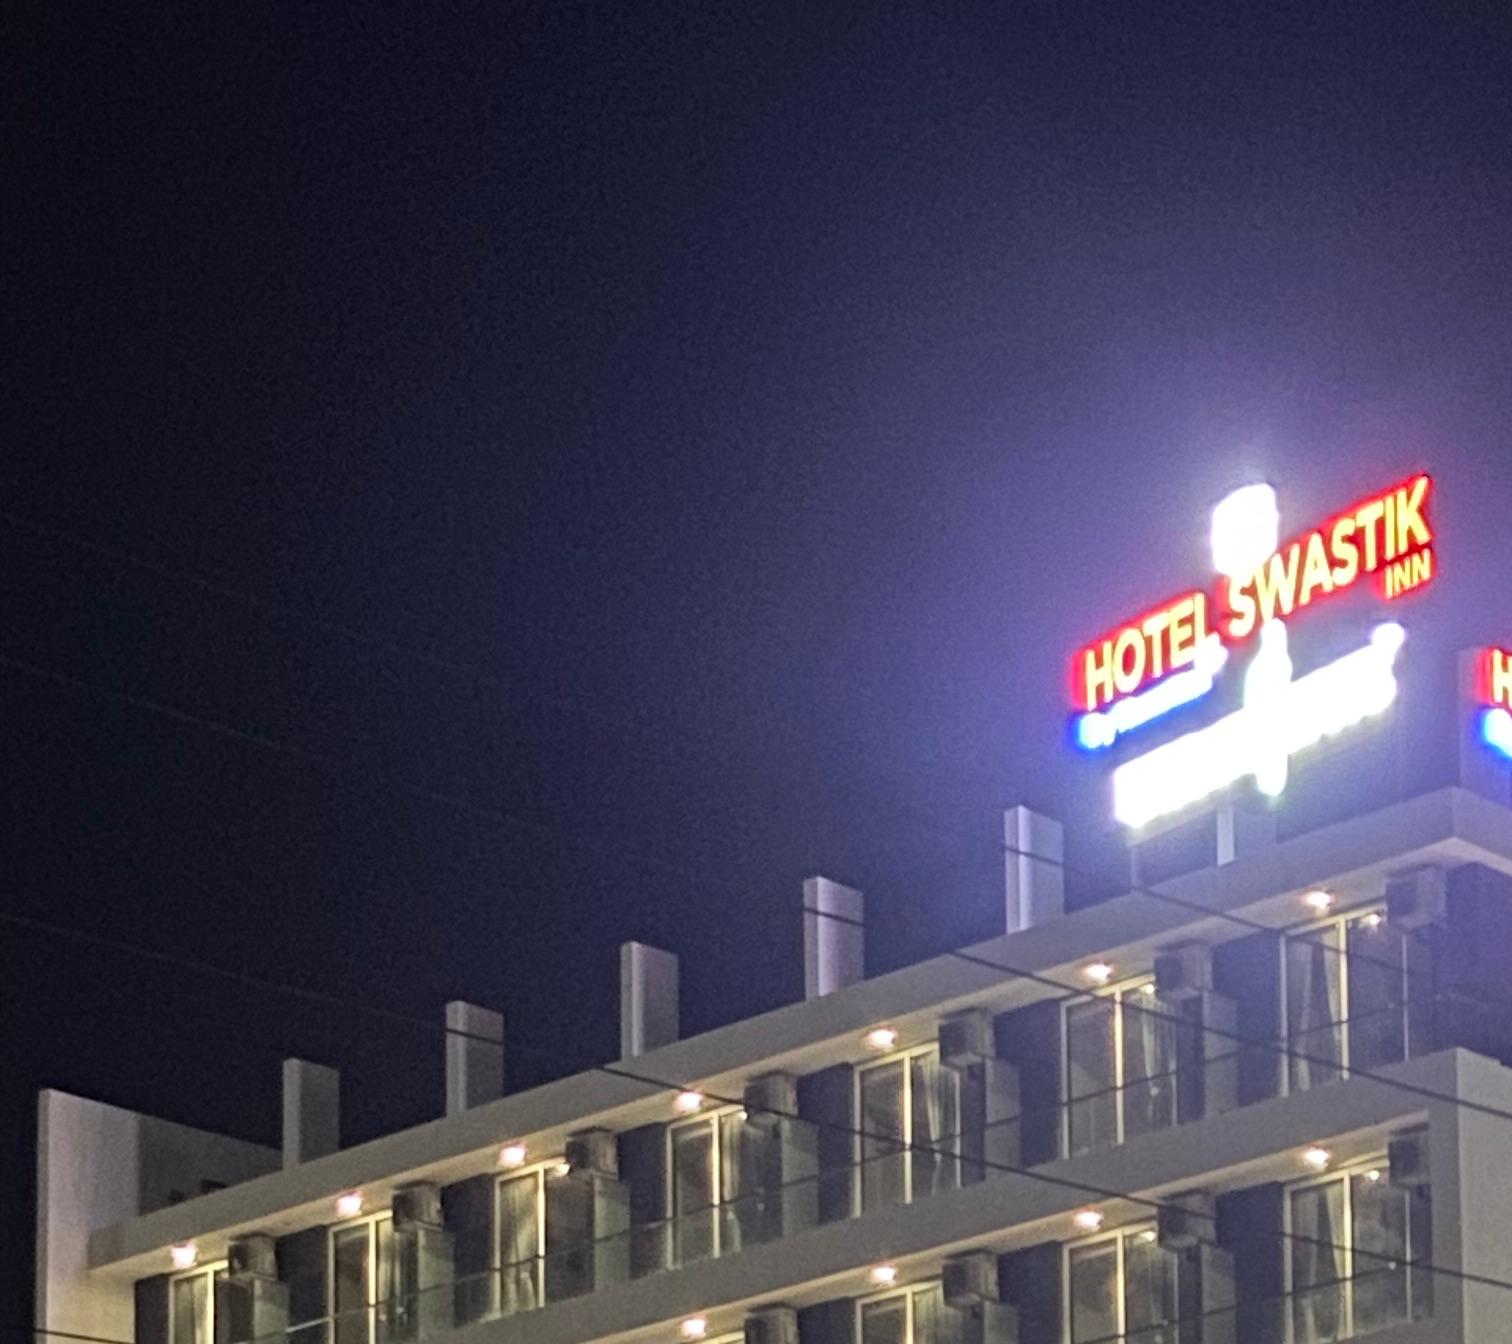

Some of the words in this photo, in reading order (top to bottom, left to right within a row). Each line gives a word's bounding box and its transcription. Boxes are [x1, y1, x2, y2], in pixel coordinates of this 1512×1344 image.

[1085, 592, 1212, 712] HOTEL
[1228, 476, 1432, 637] SWASTIK
[1385, 549, 1431, 599] INN
